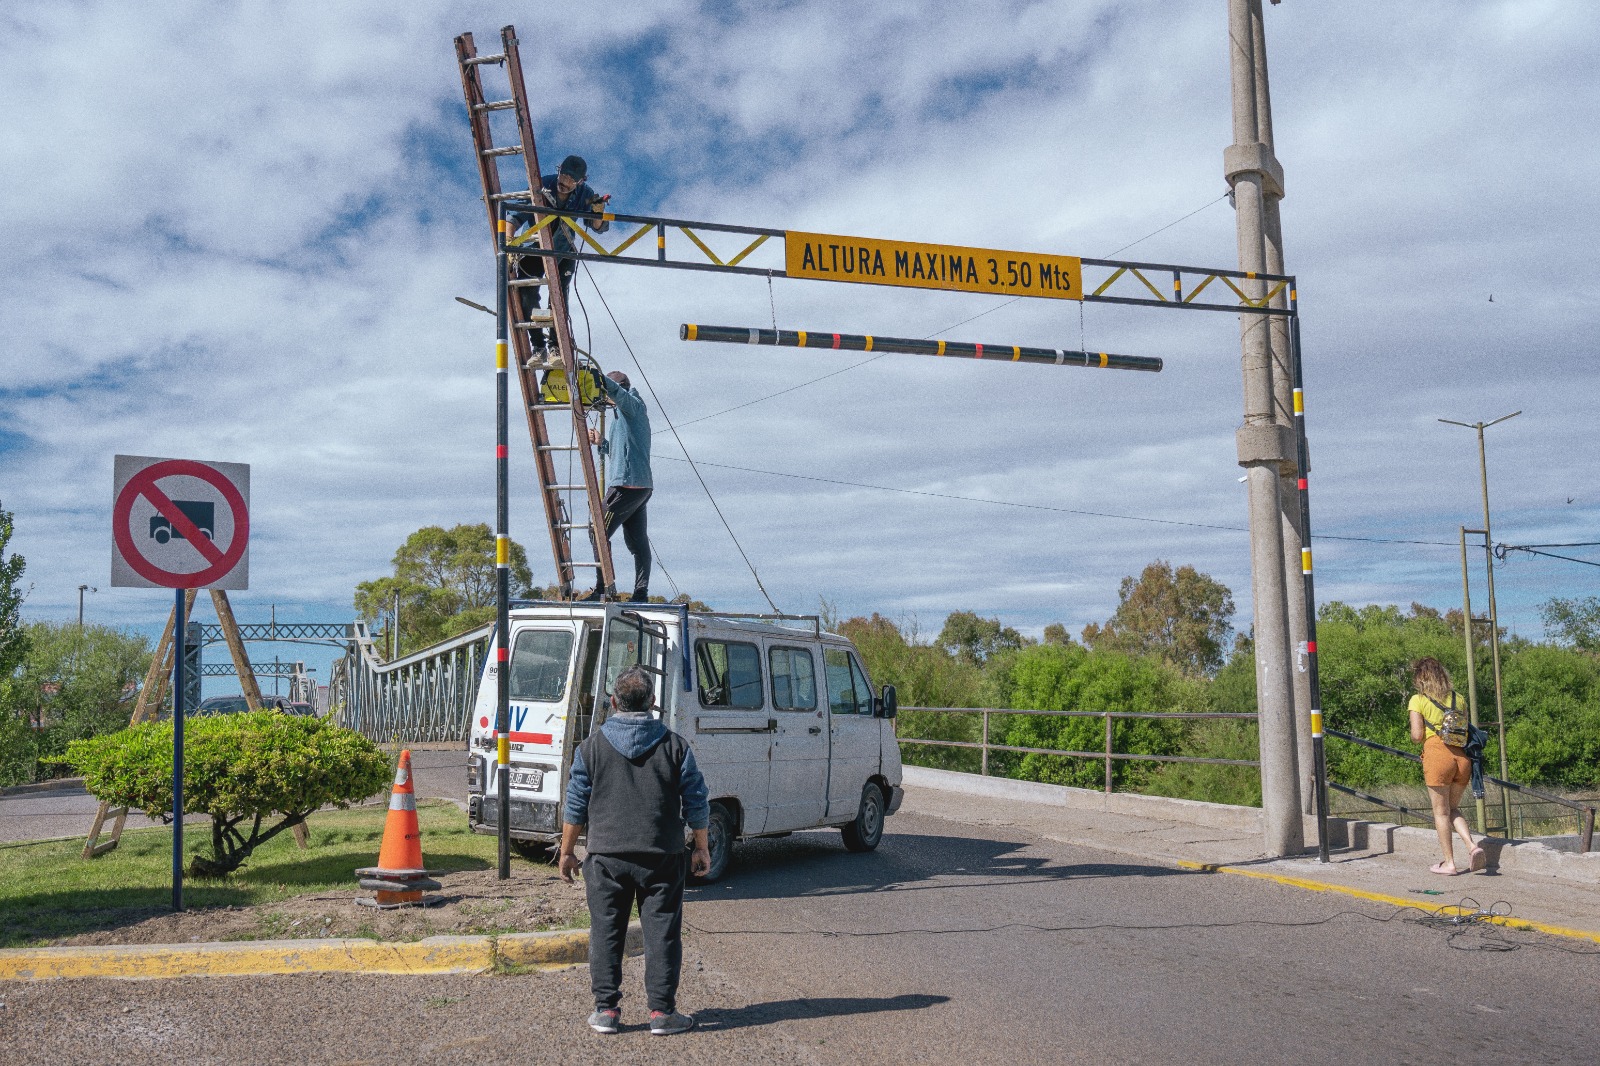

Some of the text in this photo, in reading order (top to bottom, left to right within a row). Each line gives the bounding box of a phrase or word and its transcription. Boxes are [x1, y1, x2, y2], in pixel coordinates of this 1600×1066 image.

[802, 243, 1071, 290] ALTURA MAXIMA 3.50 Mts
